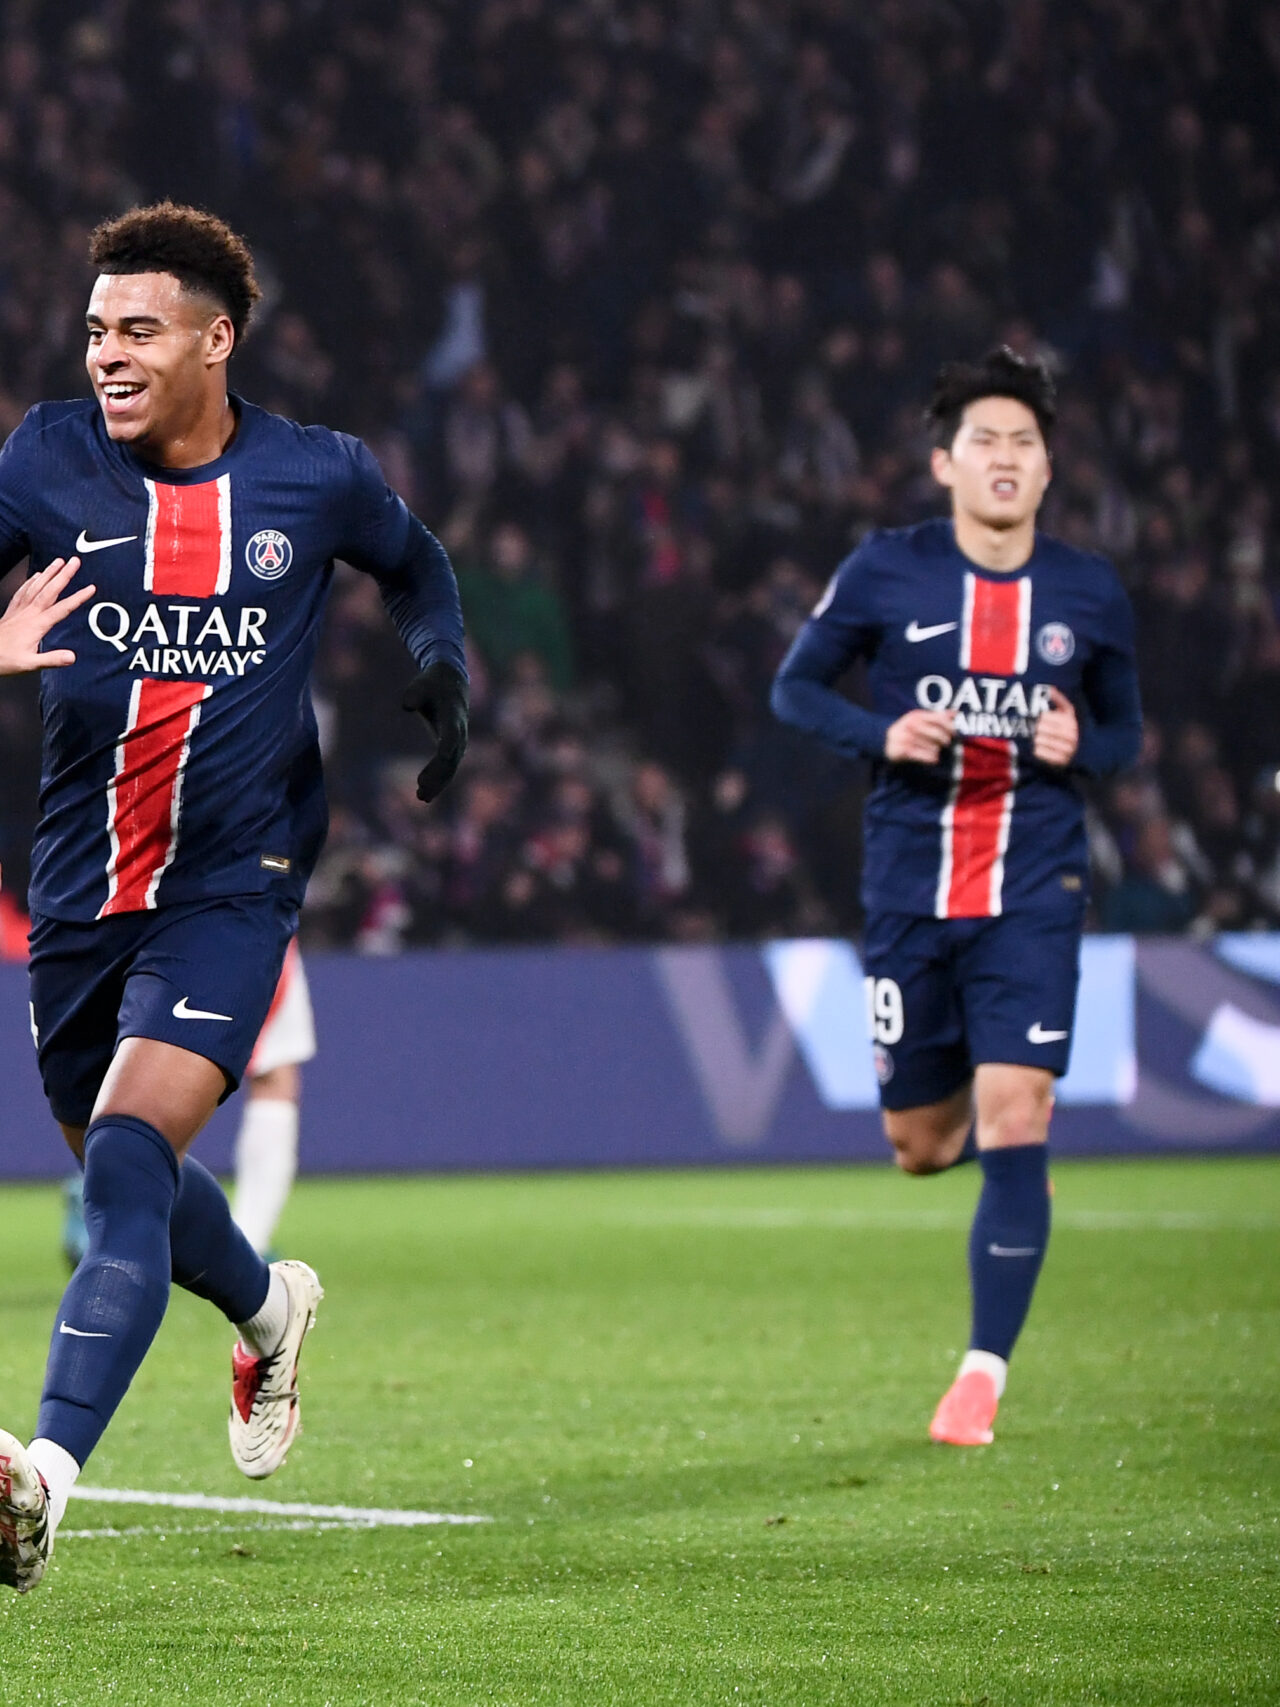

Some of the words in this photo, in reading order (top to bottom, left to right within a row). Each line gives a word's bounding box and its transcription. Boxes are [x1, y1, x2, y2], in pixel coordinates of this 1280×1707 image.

[254, 532, 285, 545] PARIS
[88, 601, 267, 653] QATAR
[915, 674, 1053, 717] QATAR
